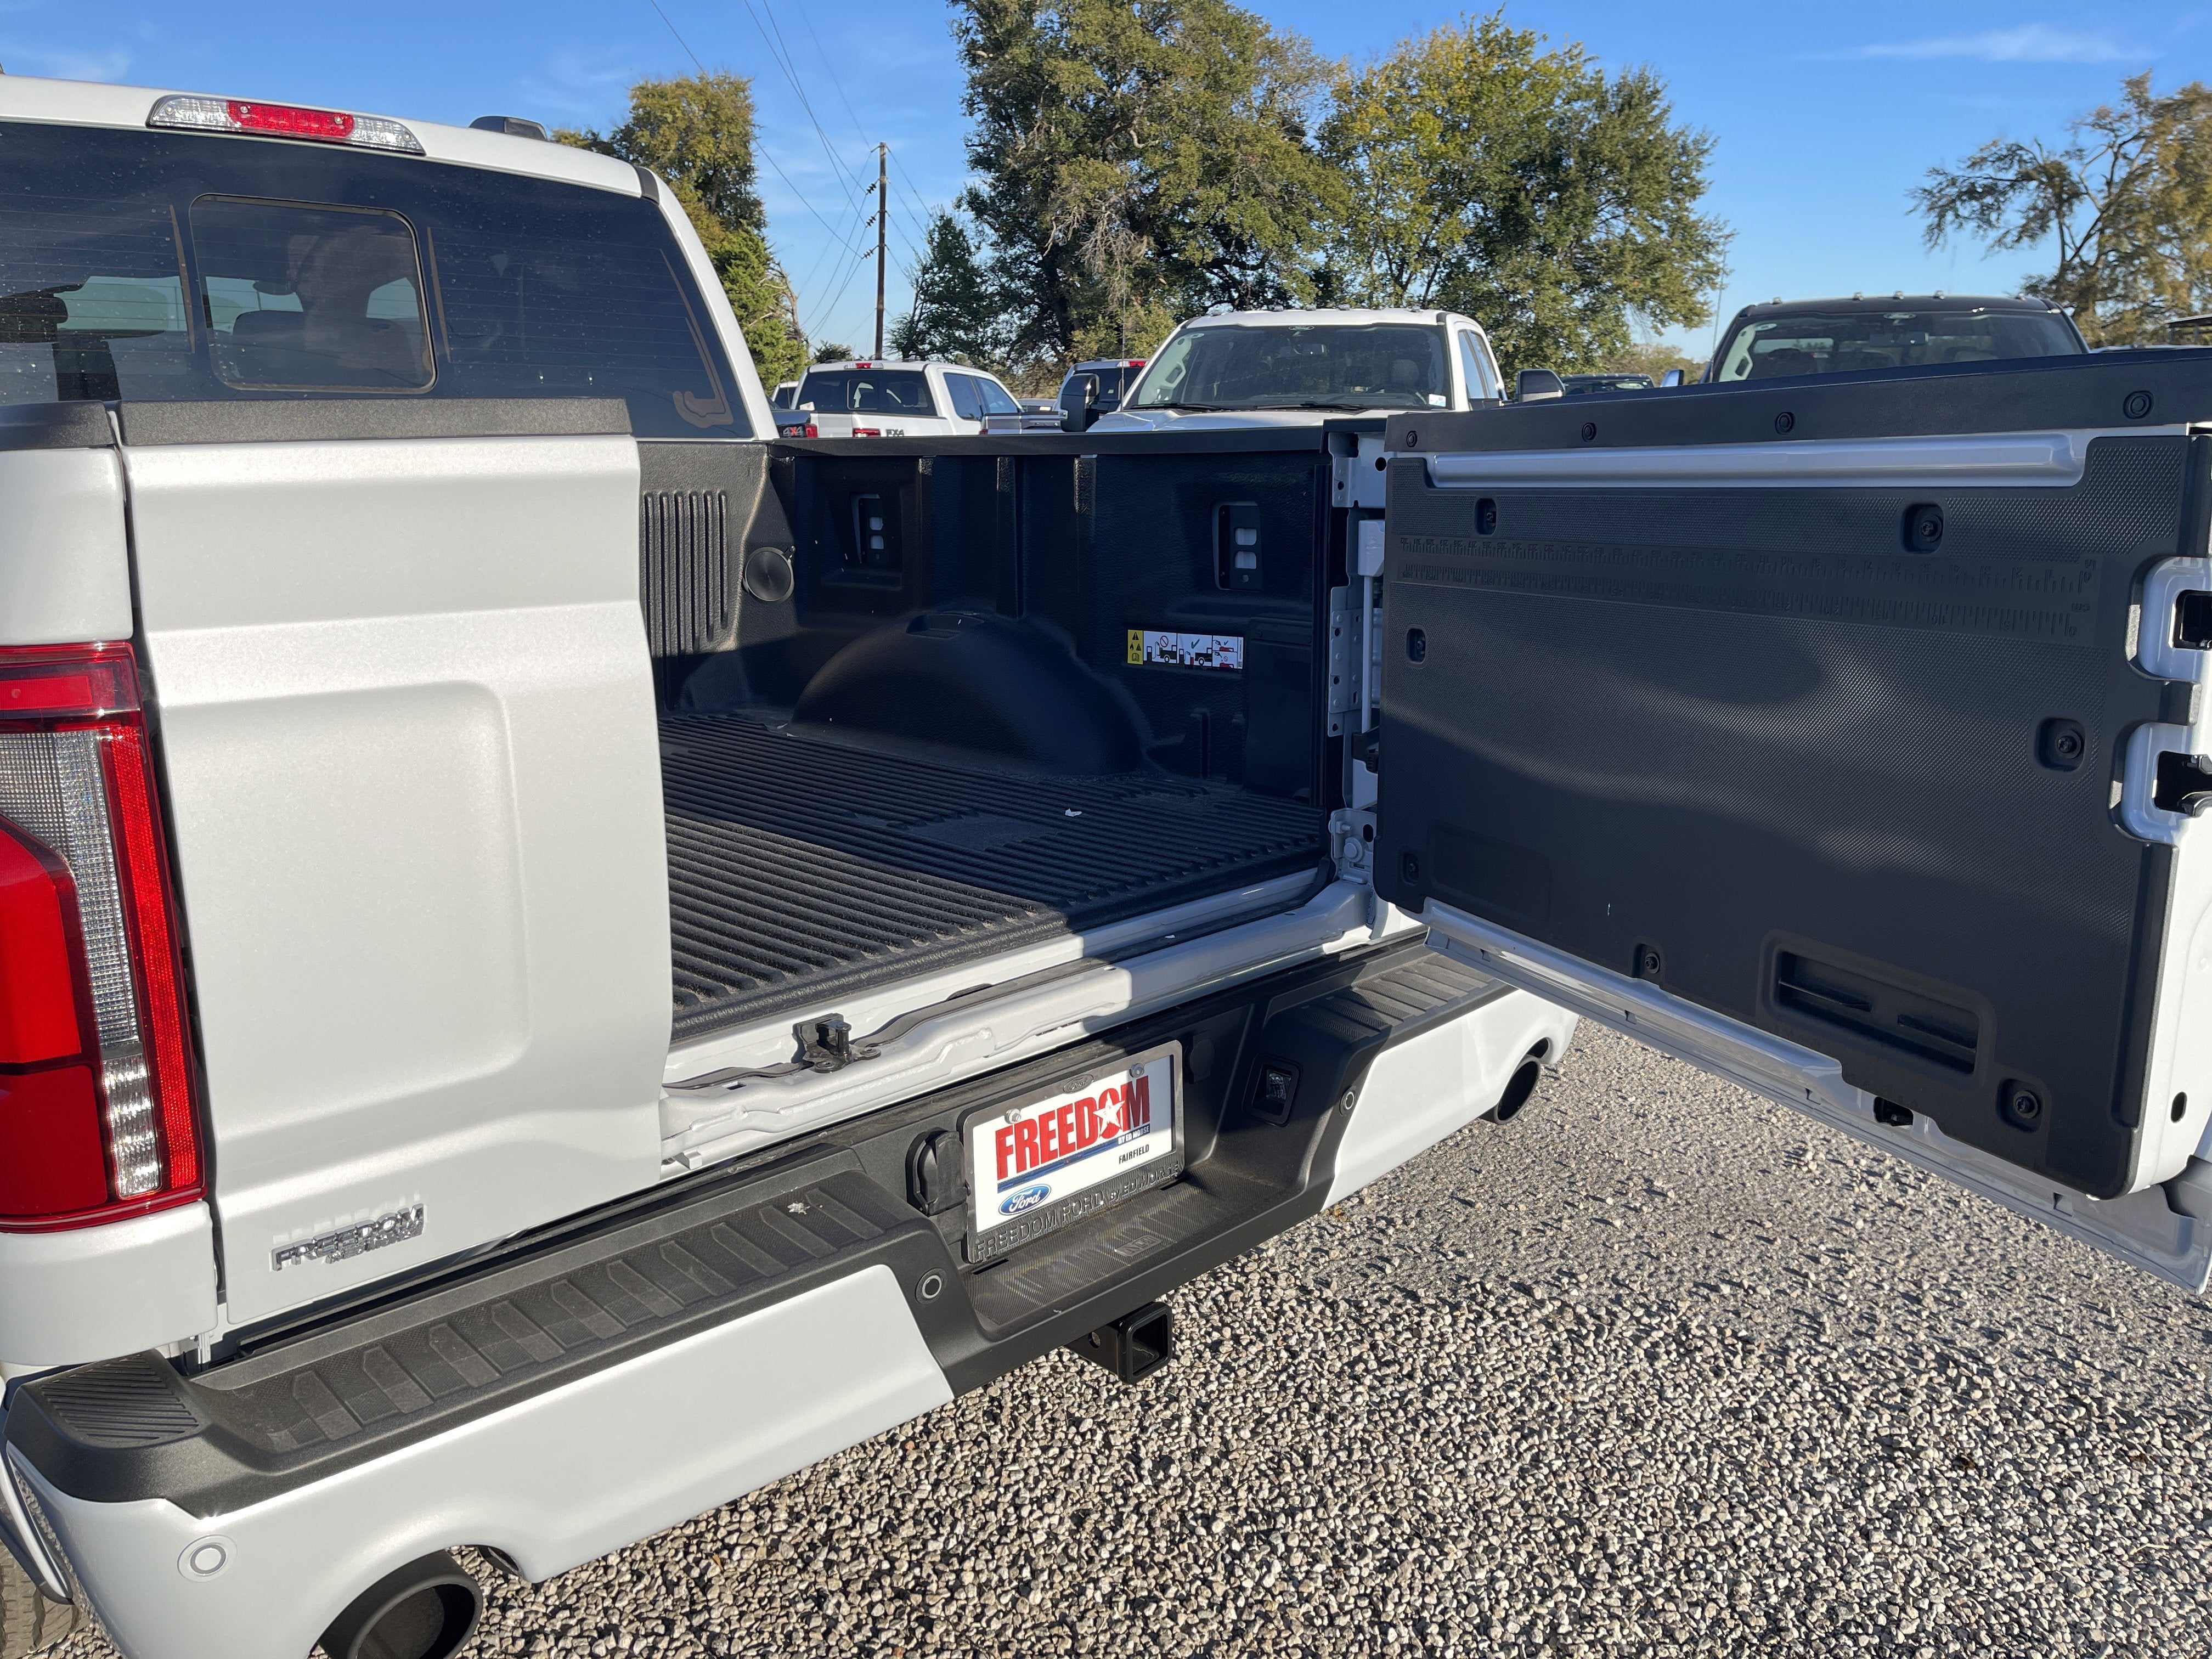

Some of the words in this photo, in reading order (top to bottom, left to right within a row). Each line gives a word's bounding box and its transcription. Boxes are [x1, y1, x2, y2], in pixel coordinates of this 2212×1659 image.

[995, 1075, 1150, 1181] FREEDOM
[1118, 1135, 1125, 1145] BY
[1125, 1132, 1132, 1142] ED
[1132, 1125, 1149, 1139] MORSE
[1119, 1144, 1149, 1165] FAIRFIELD
[976, 1209, 1057, 1263] FREEDOM
[1061, 1189, 1104, 1223] FORD
[1122, 1178, 1138, 1198] ED
[1138, 1161, 1179, 1190] MORSE
[1009, 1189, 1041, 1212] Ford
[271, 1203, 424, 1272] FREEDOM
